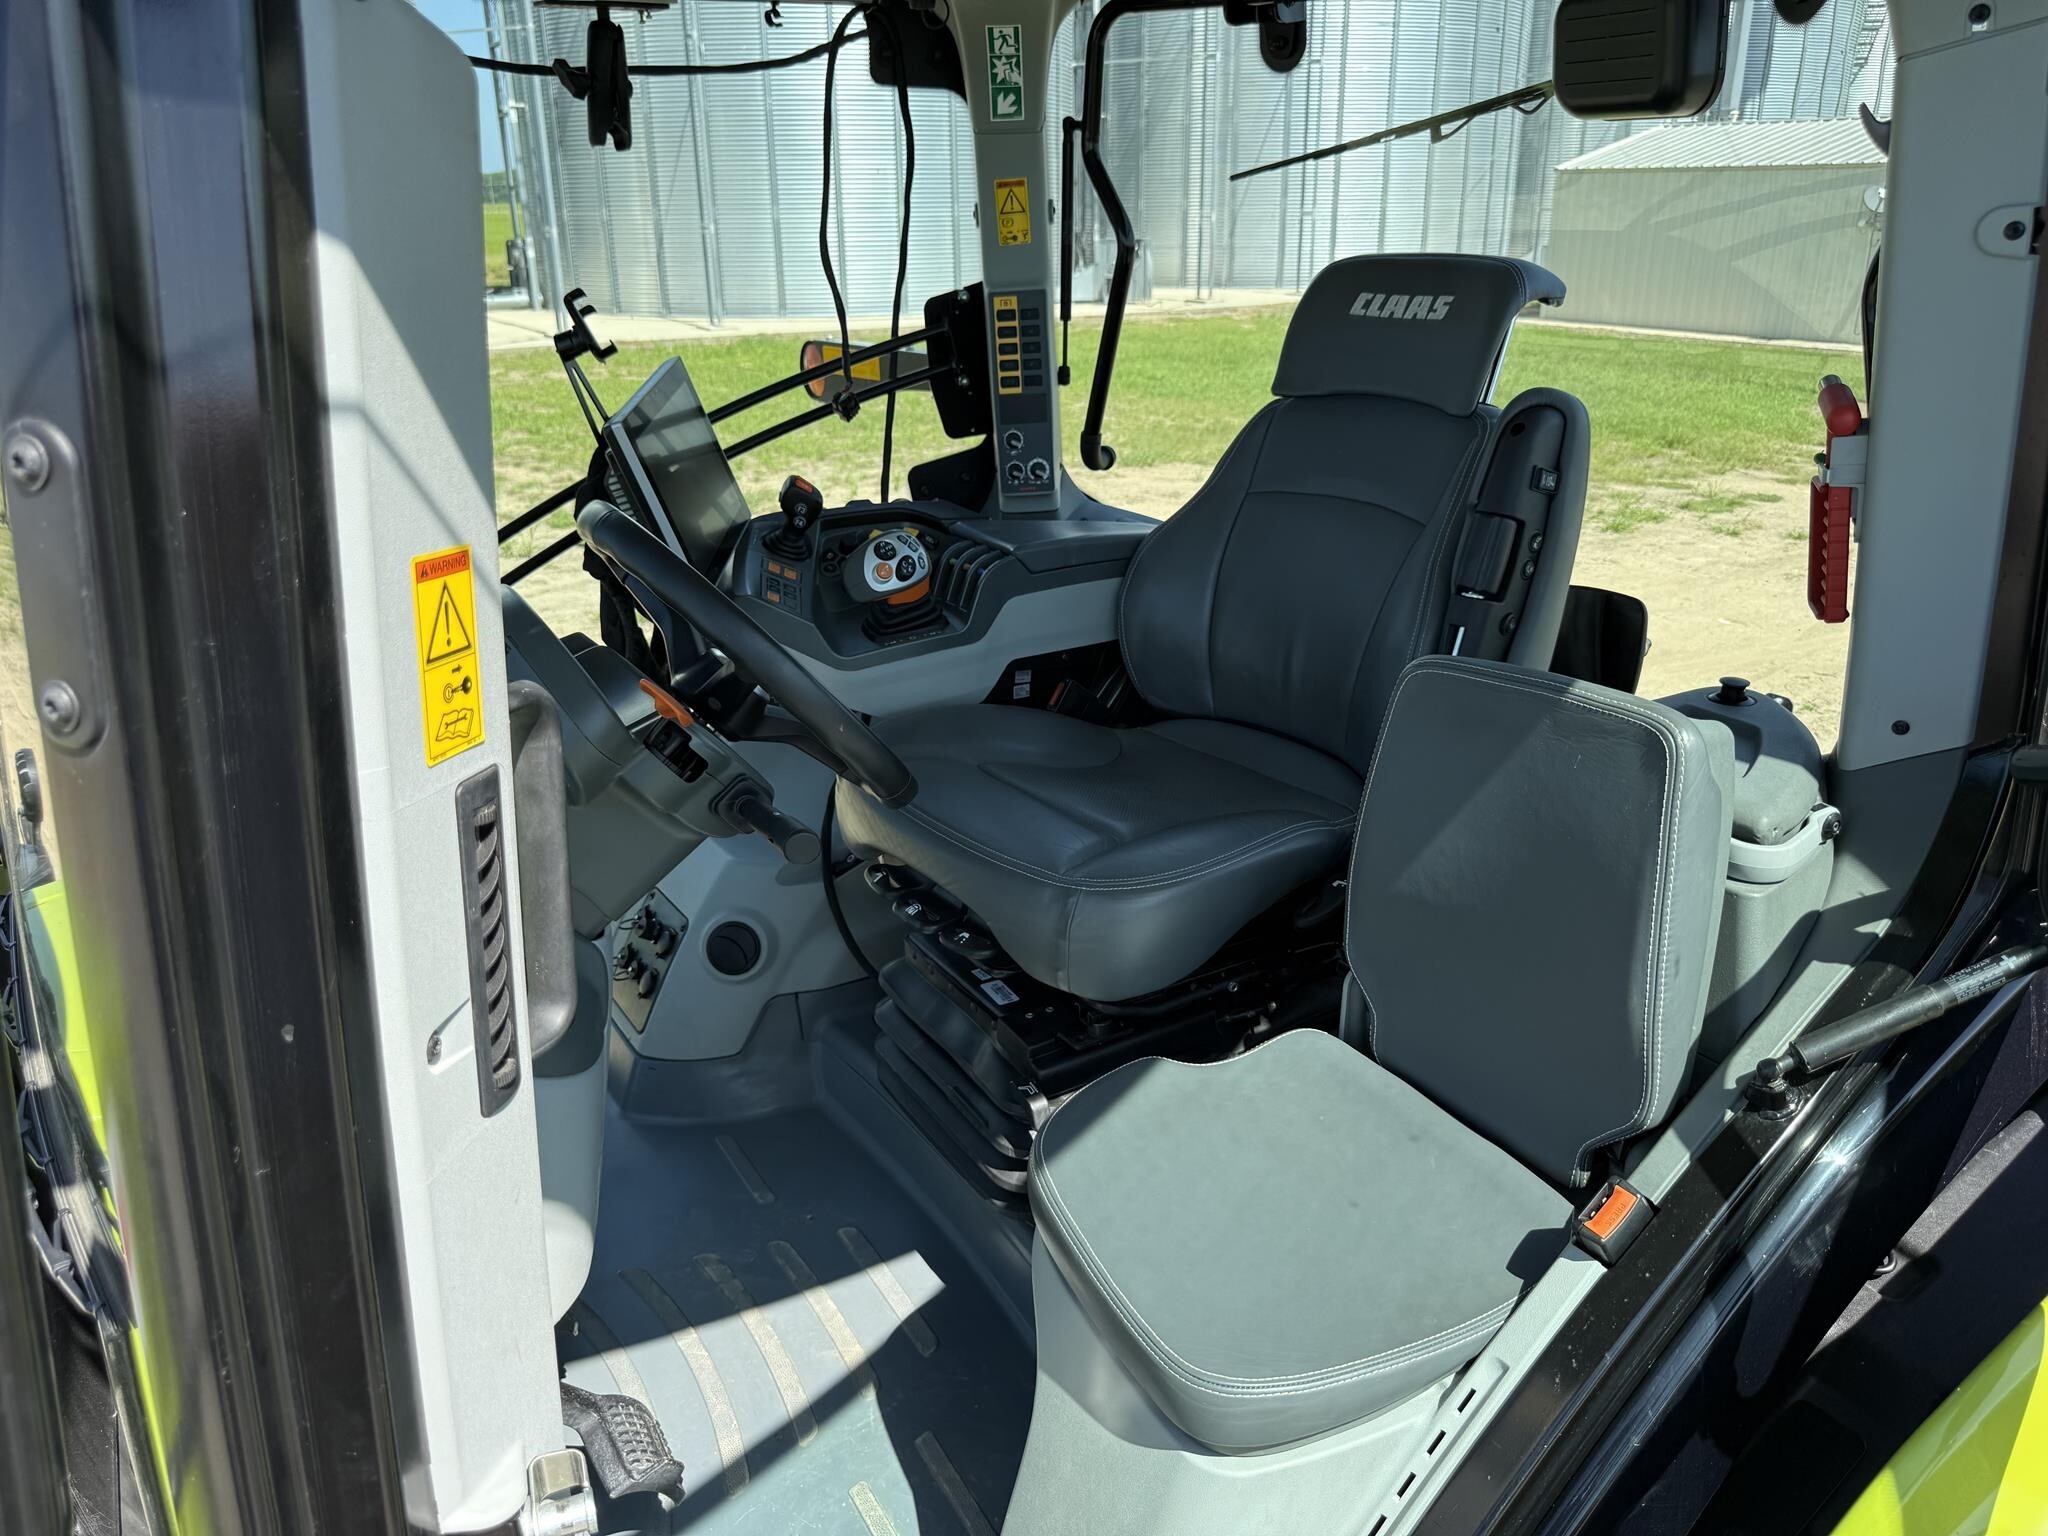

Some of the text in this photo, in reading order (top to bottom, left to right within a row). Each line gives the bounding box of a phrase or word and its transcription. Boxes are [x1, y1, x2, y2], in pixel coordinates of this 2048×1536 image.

[1349, 292, 1455, 320] CLAAS
[429, 554, 467, 574] WARNING
[1605, 1203, 1626, 1226] PRESS
